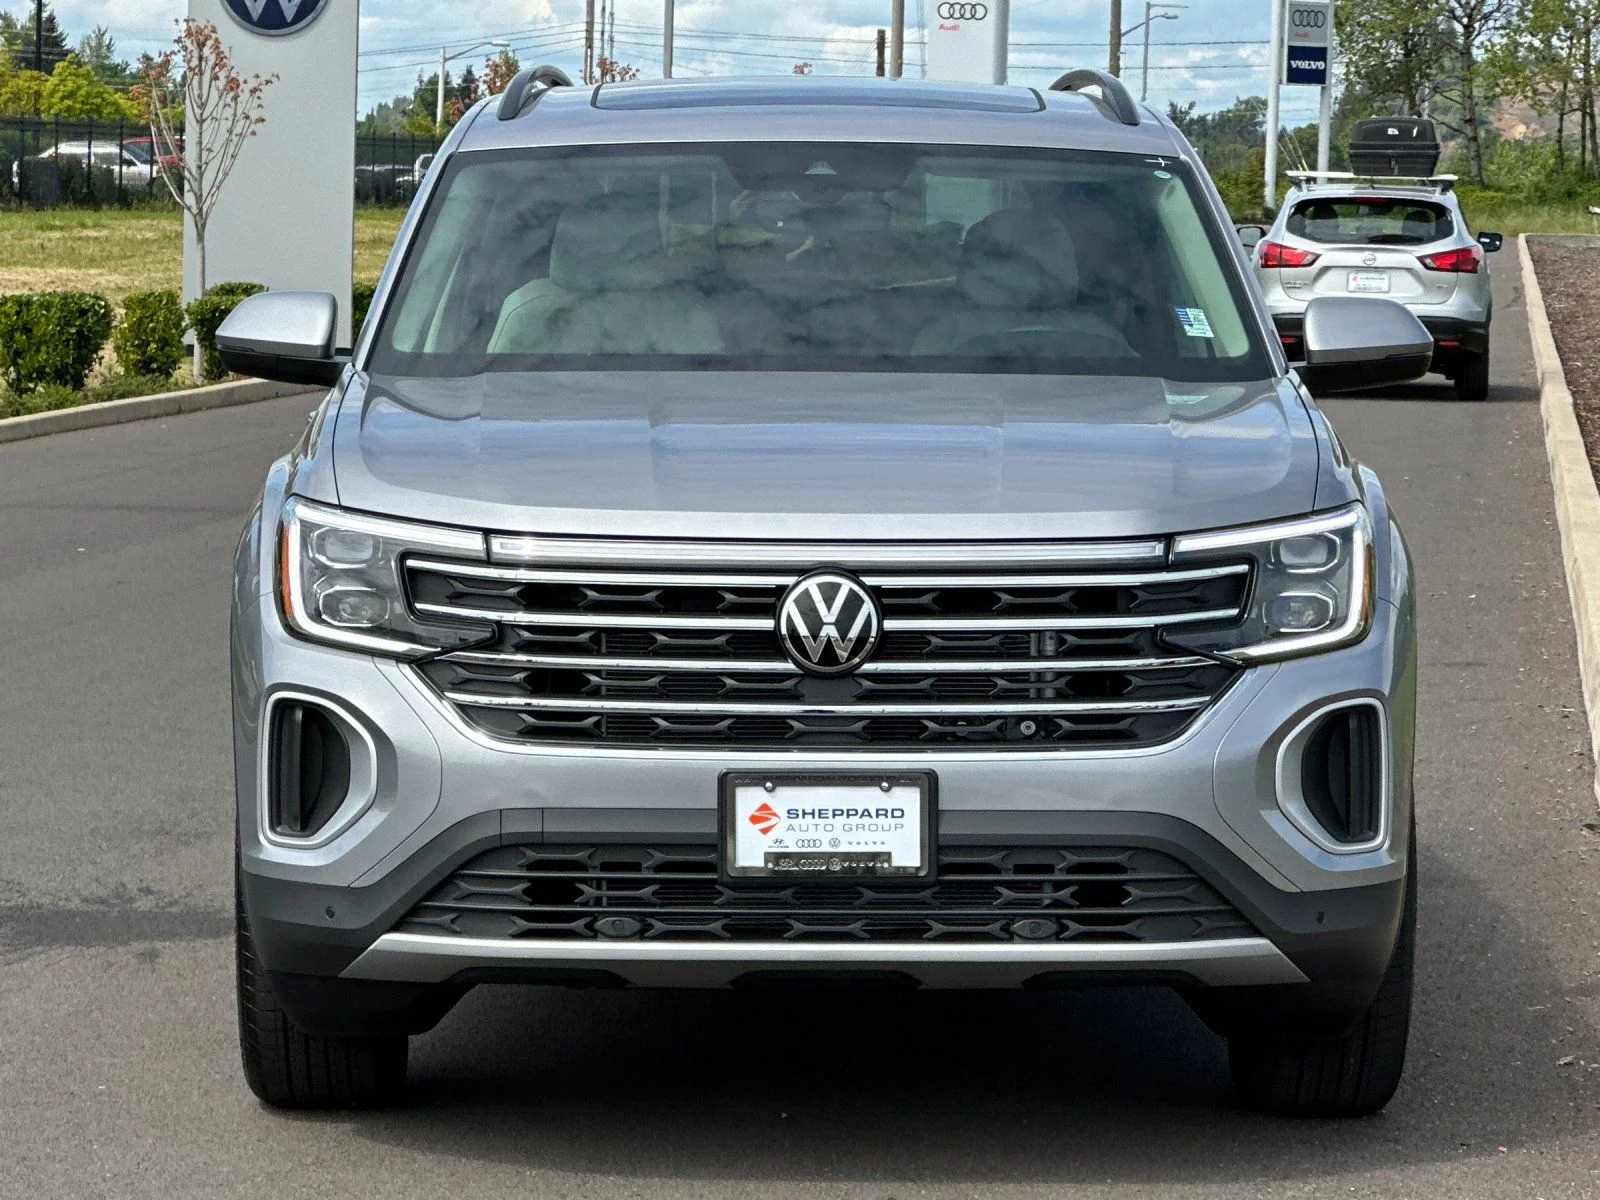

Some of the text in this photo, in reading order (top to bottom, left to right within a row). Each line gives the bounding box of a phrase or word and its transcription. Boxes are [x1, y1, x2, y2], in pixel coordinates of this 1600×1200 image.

[1290, 60, 1326, 70] VOLVO
[786, 808, 905, 819] SHEPPARD
[786, 823, 904, 832] AUTO GROUP
